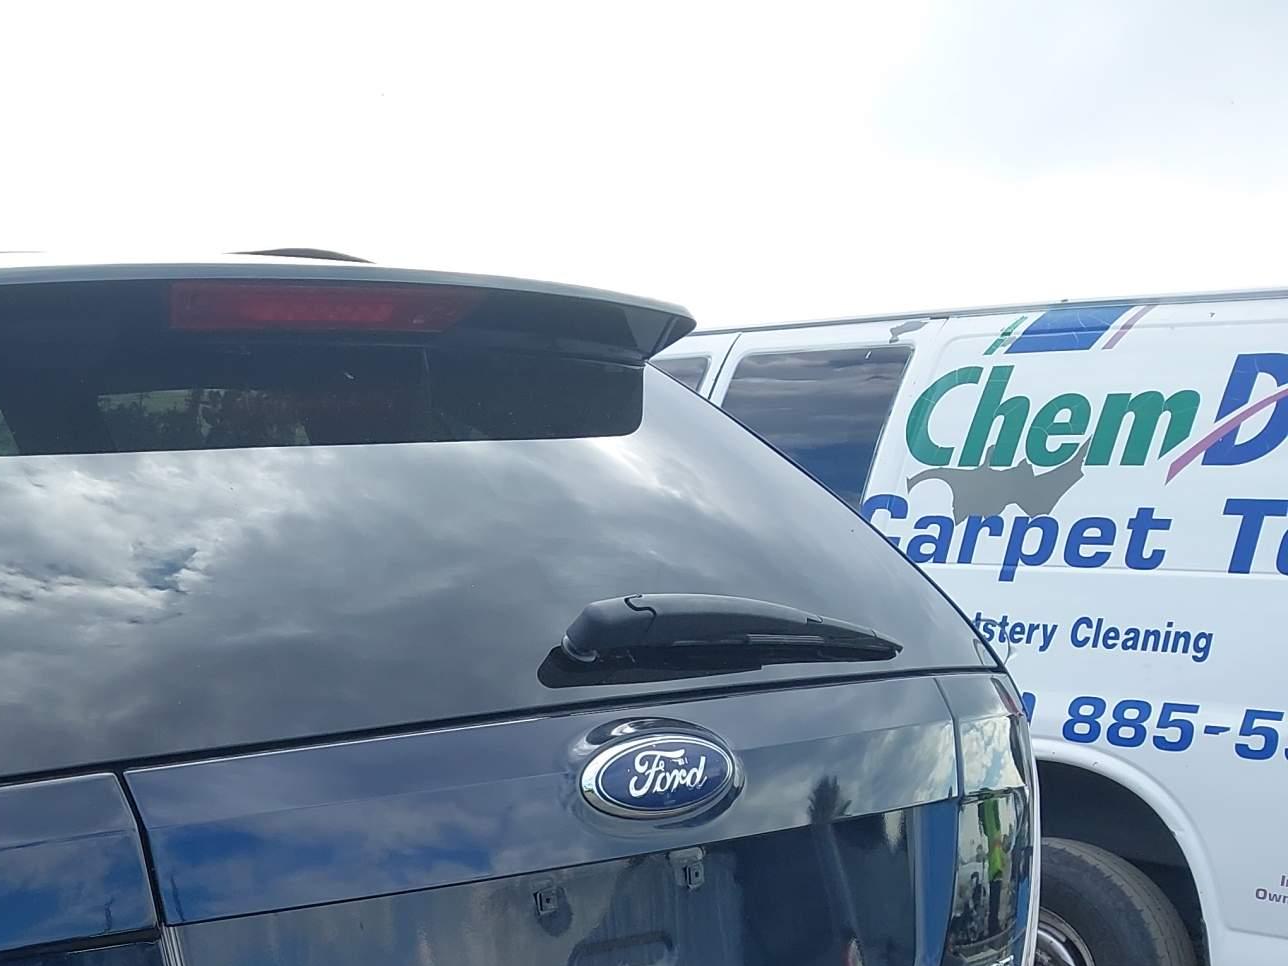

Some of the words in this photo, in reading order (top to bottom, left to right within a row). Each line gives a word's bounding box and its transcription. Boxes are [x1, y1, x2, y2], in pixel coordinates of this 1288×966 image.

[905, 364, 1201, 467] Chem
[1070, 616, 1214, 663] Cleaning
[1062, 696, 1288, 761] 885-5
[628, 746, 708, 798] Ford
